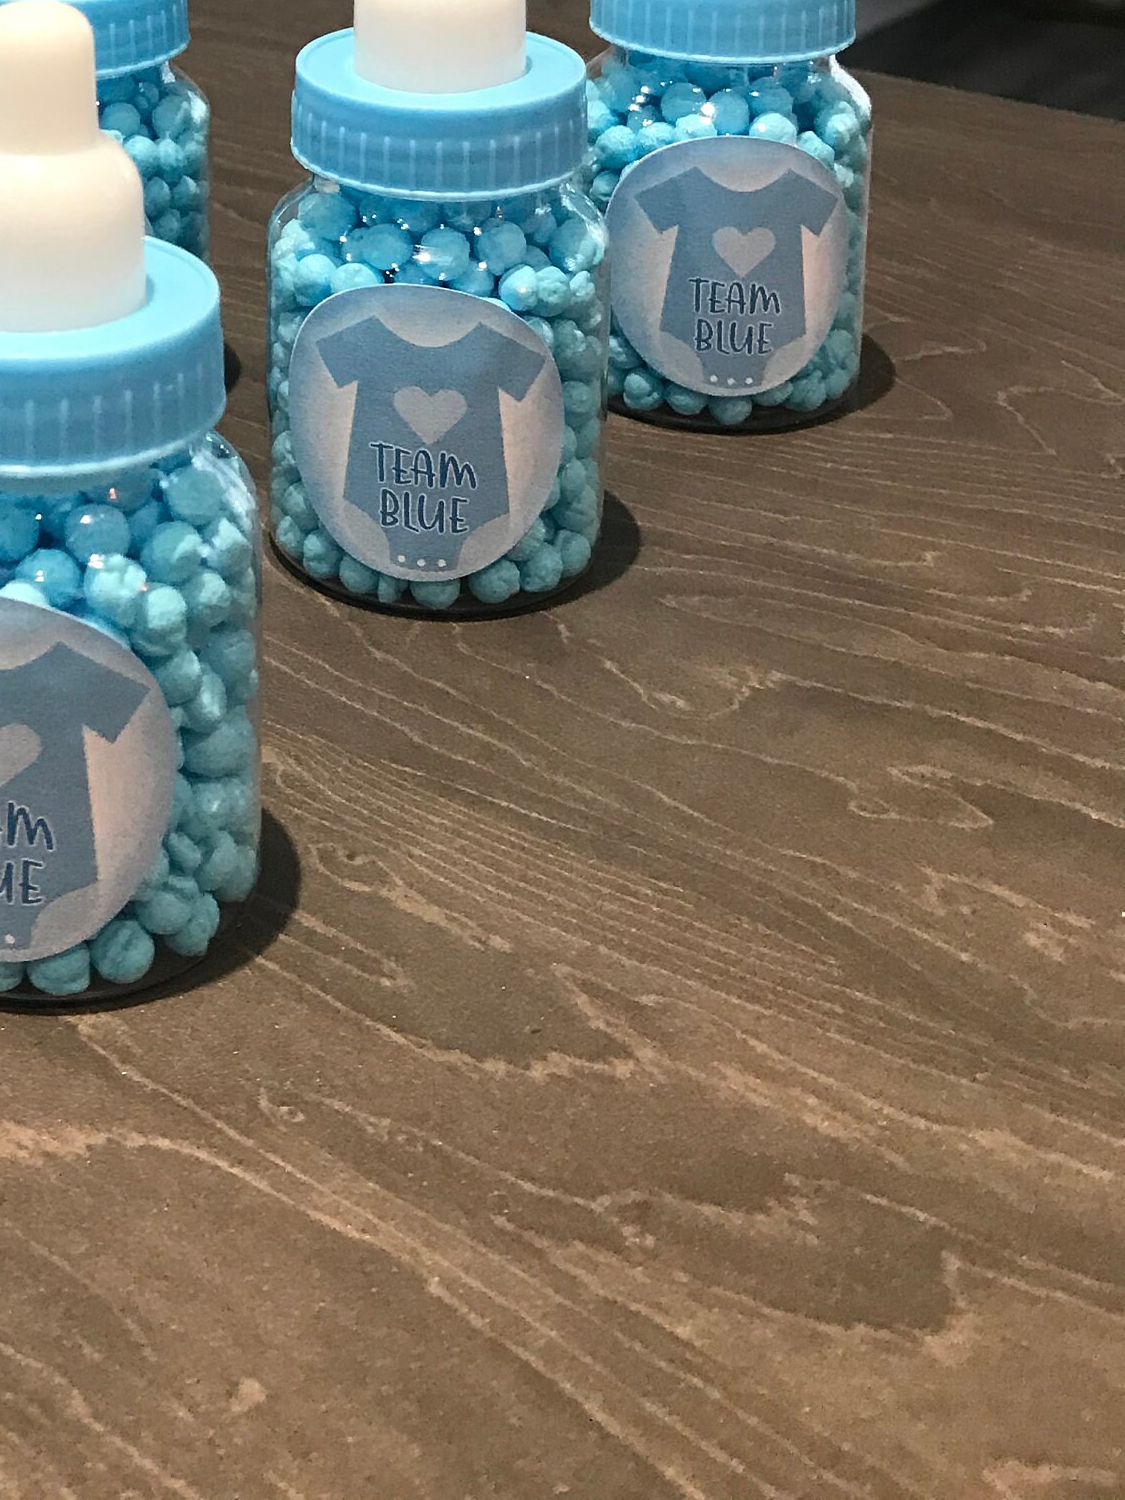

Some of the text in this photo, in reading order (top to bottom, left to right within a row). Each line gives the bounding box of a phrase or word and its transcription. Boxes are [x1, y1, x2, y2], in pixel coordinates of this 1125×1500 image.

[689, 277, 780, 314] TEAM
[695, 318, 772, 354] BLUE
[370, 442, 477, 489] TEAM
[379, 488, 468, 534] BLUE
